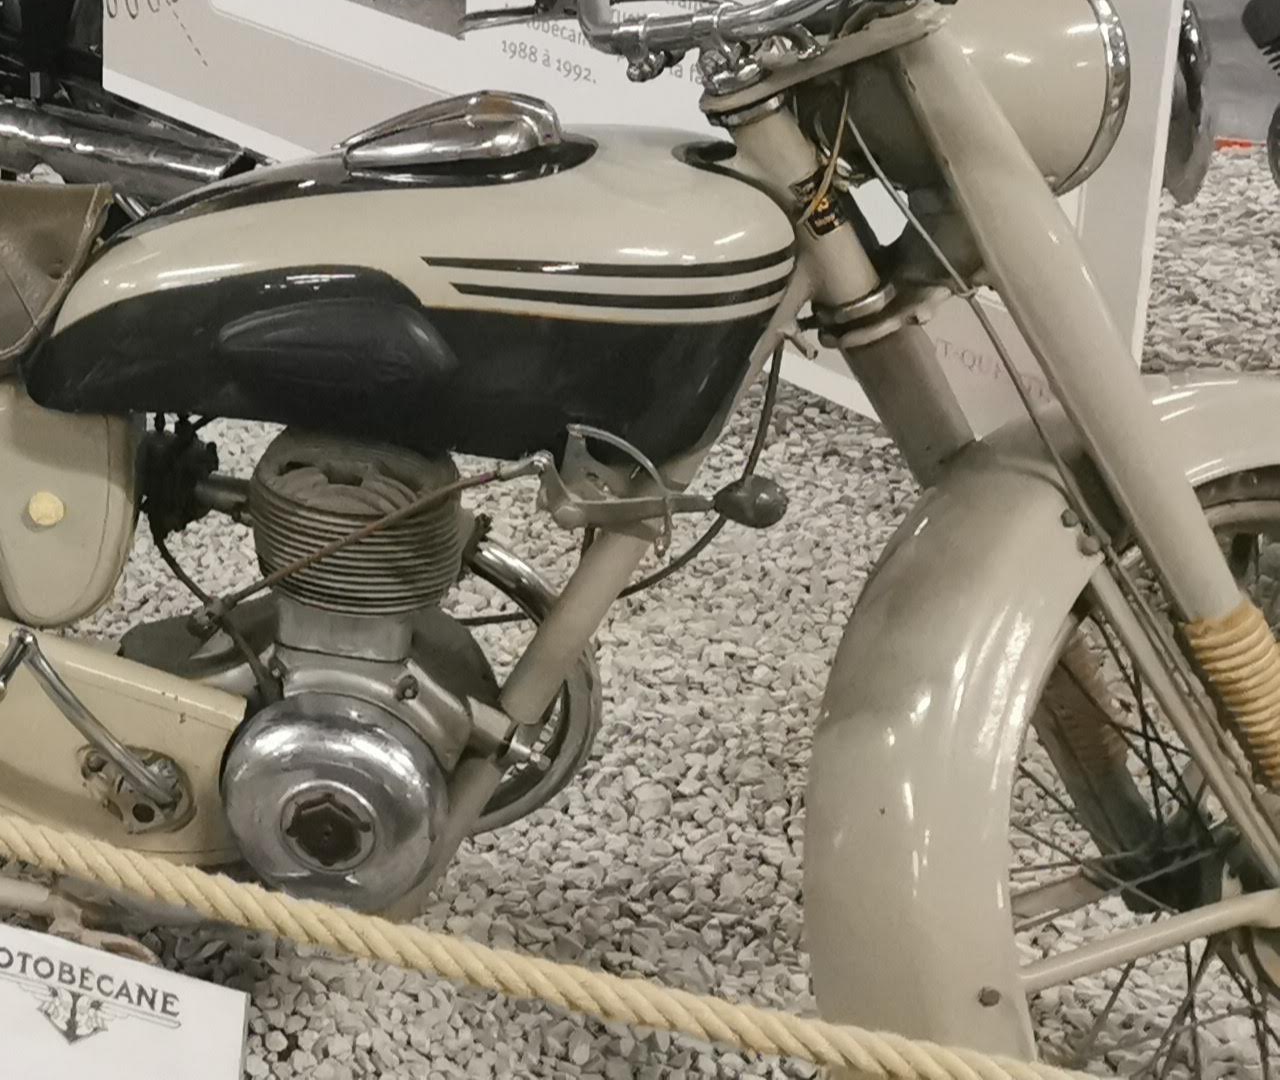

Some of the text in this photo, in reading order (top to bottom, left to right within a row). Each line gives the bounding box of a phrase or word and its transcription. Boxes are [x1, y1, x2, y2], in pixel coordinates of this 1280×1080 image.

[500, 39, 598, 85] 1988 à 1992.
